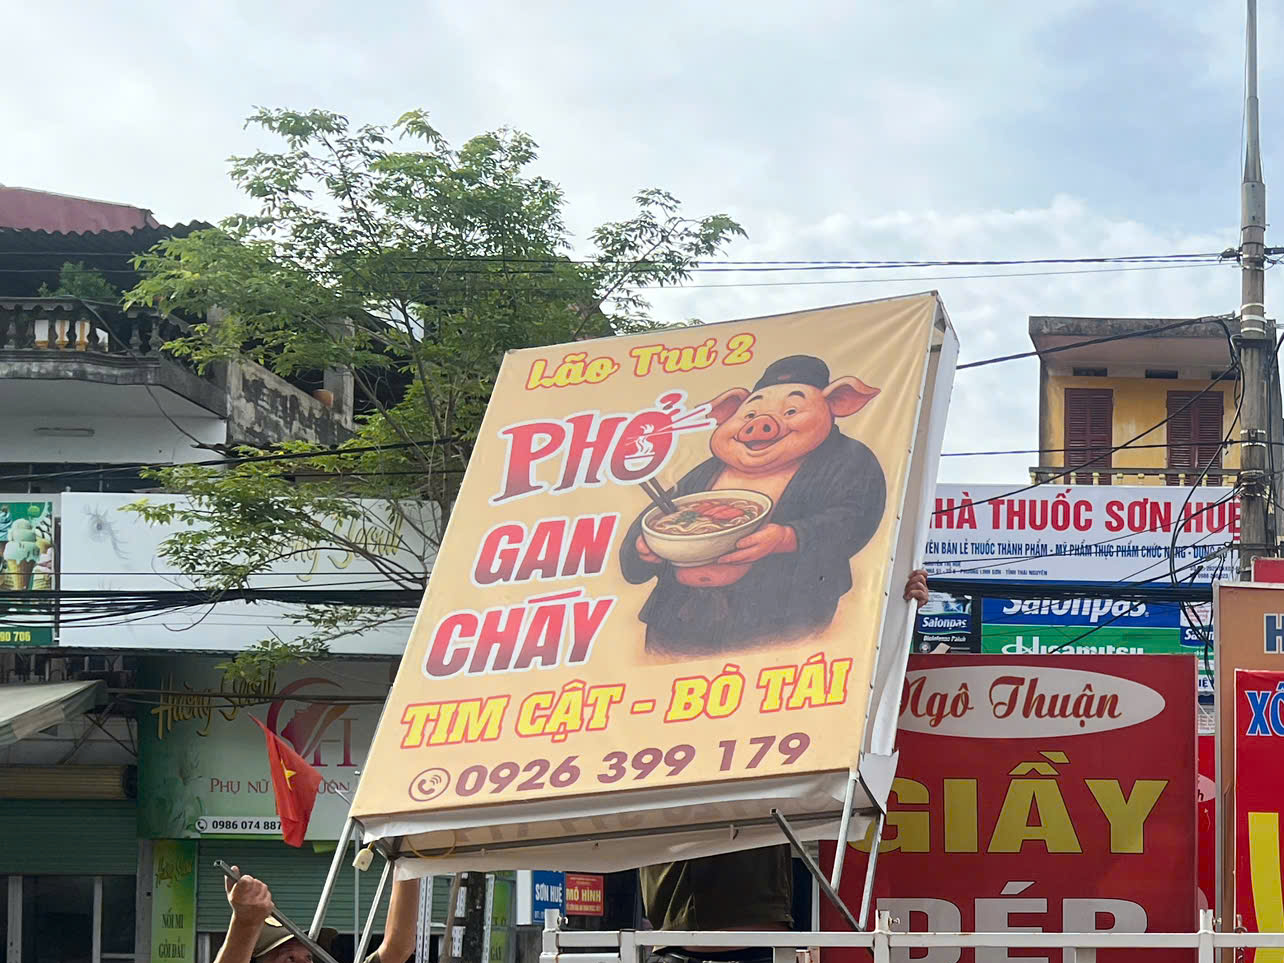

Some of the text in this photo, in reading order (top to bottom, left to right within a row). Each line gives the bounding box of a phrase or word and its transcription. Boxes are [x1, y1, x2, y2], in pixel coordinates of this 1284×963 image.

[526, 332, 756, 391] Lão Trư 2
[489, 391, 700, 506] PHỞ
[929, 491, 977, 530] HÀ
[988, 488, 1094, 532] THUỐC
[1105, 497, 1171, 533] SƠN
[473, 512, 620, 587] GAN
[1164, 545, 1186, 559] NNG
[922, 616, 968, 630] Salonpas
[400, 696, 511, 750] TIM
[515, 679, 625, 747] CẬT
[663, 662, 743, 724] BÒ
[756, 650, 853, 713] TÁI
[988, 675, 1122, 728] Thuận
[209, 778, 241, 795] PHỤ
[247, 778, 270, 793] NỮ
[455, 731, 811, 798] 0926 399 179
[212, 820, 238, 831] 0986
[241, 820, 260, 831] 074
